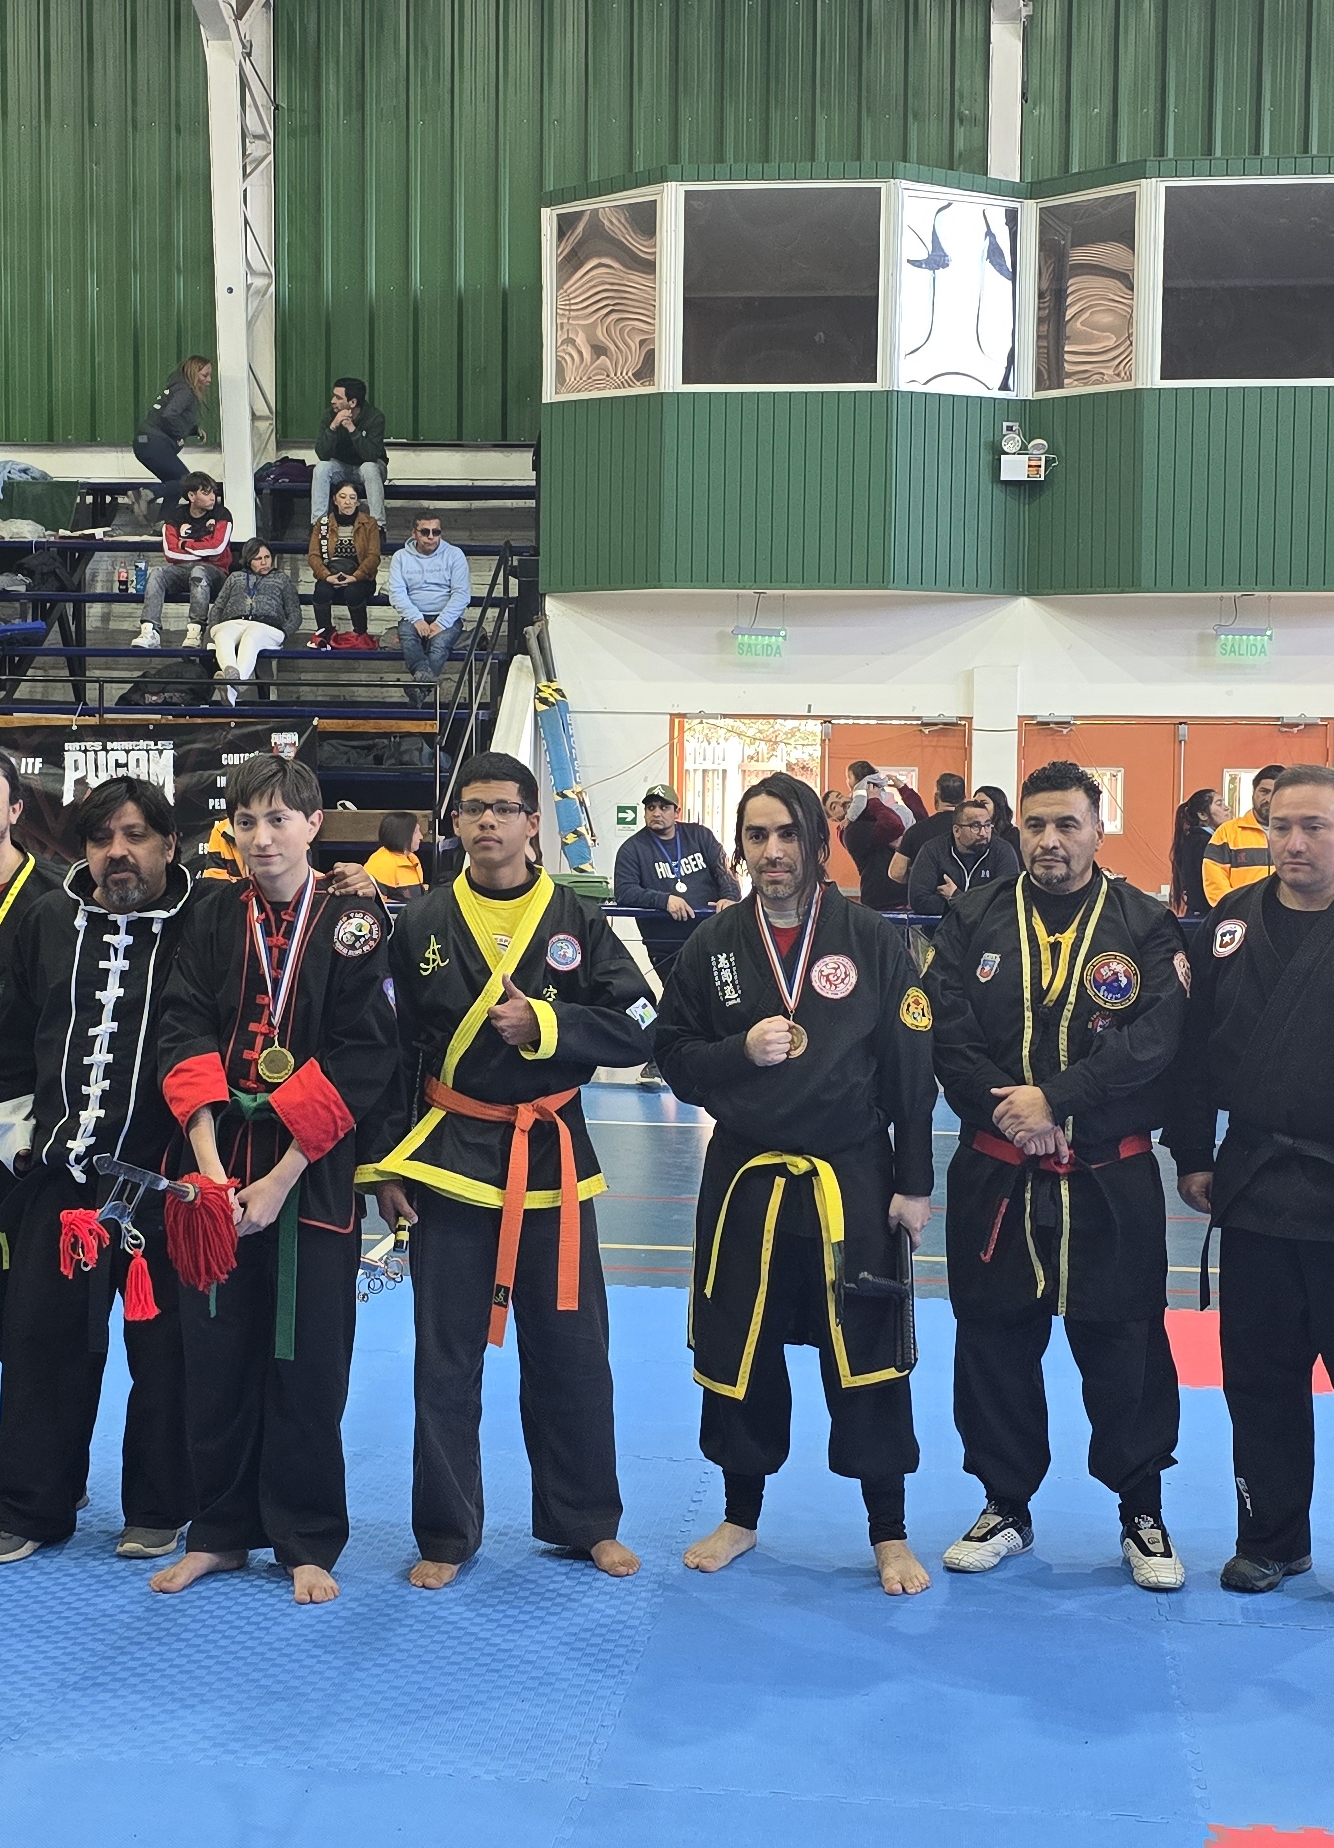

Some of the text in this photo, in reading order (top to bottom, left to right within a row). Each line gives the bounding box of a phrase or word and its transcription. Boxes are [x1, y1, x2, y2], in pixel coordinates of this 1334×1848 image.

[737, 642, 782, 657] SALIDA
[1219, 642, 1268, 657] SALIDA
[64, 742, 103, 751] ARTES
[20, 757, 43, 774] ITF
